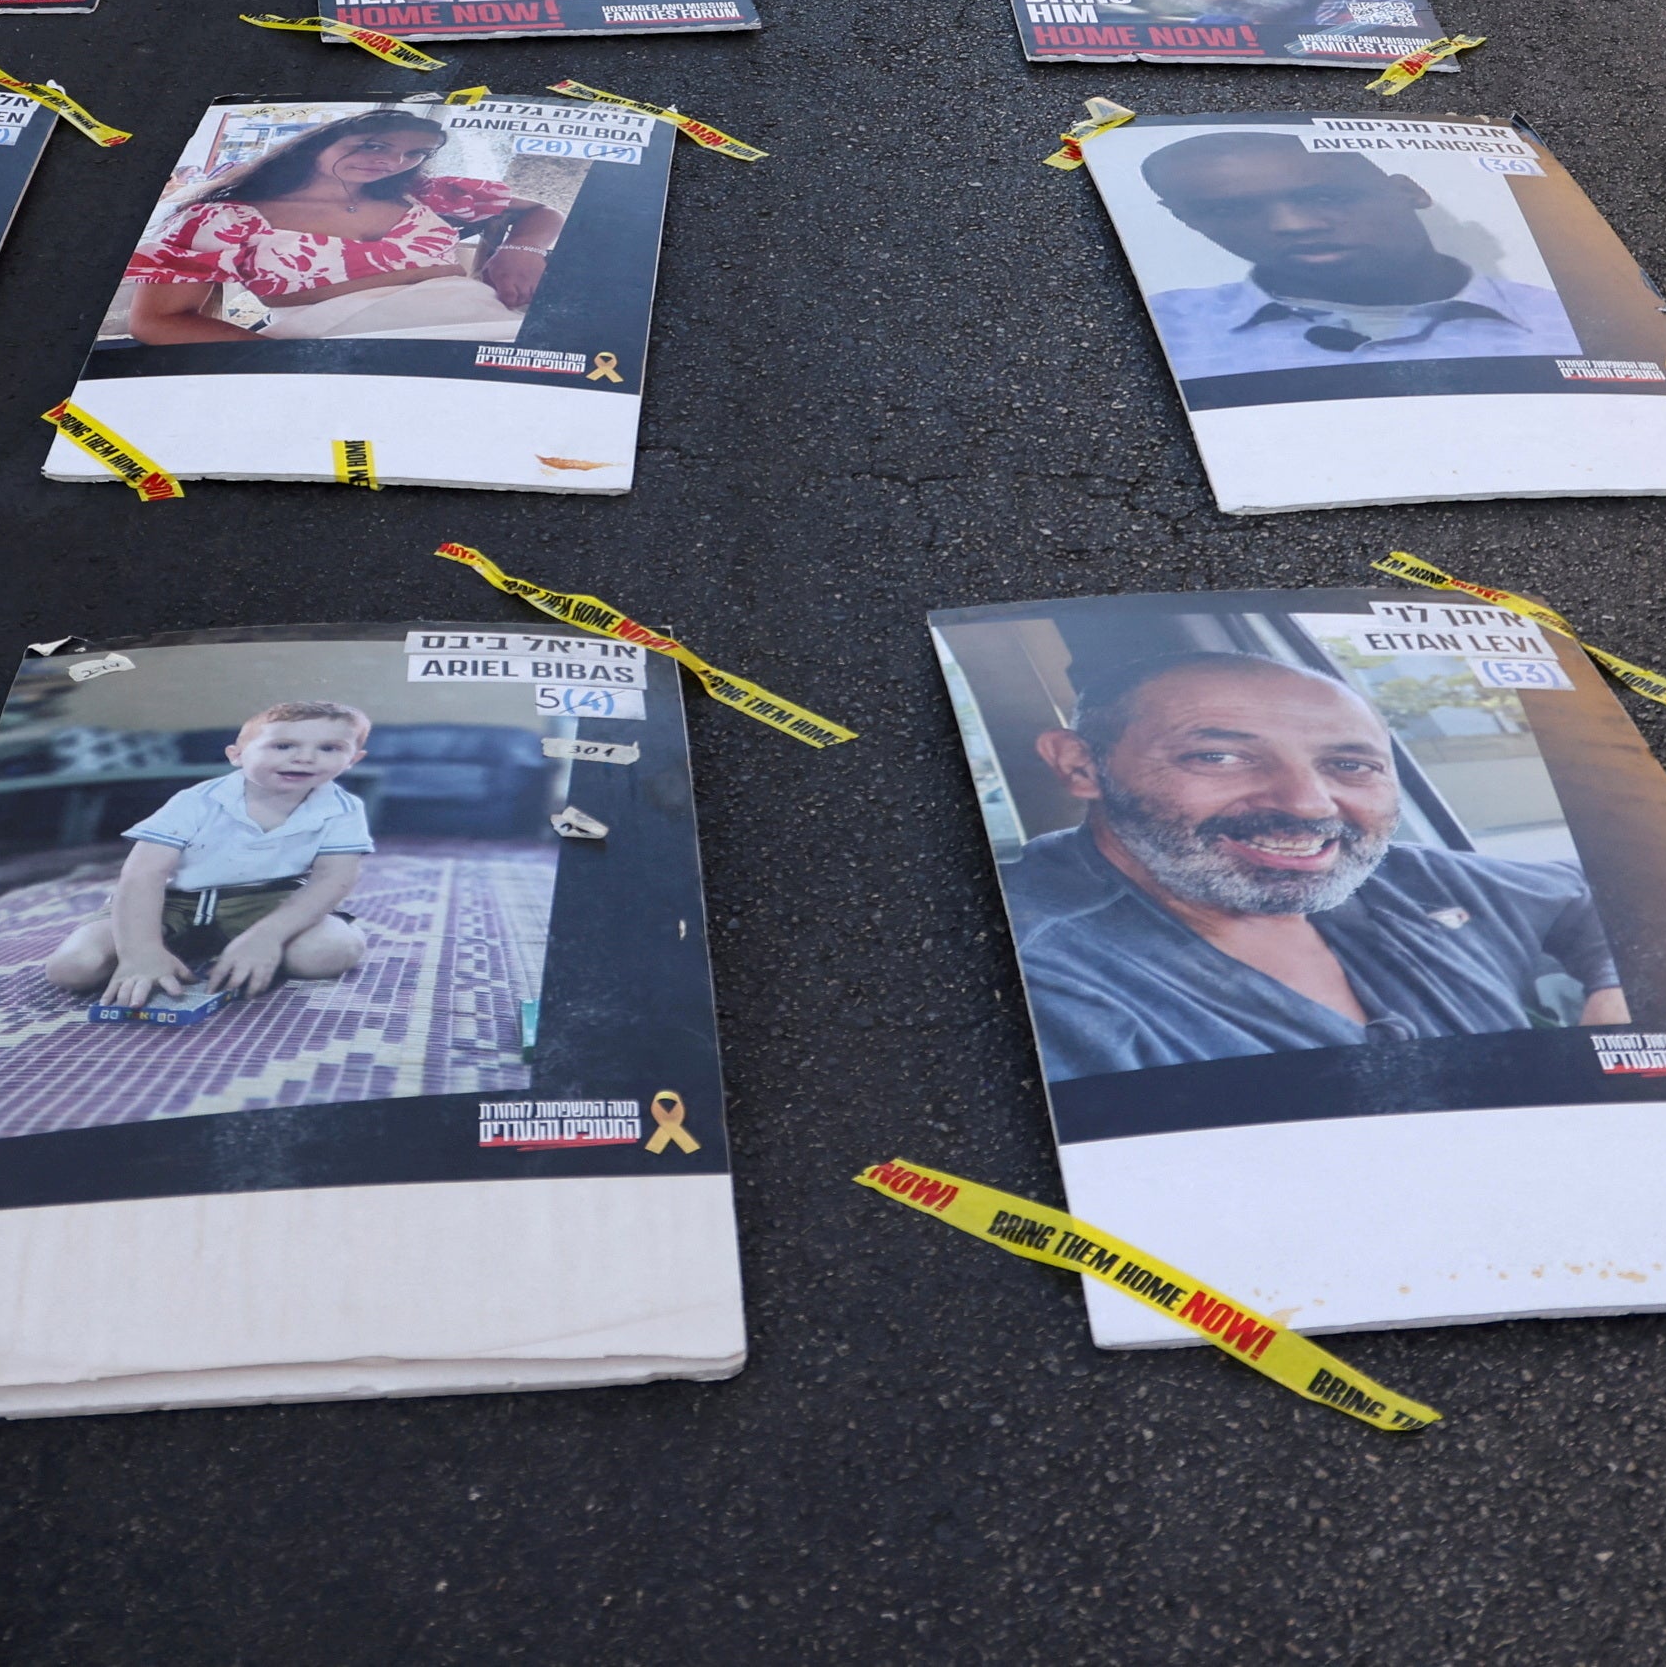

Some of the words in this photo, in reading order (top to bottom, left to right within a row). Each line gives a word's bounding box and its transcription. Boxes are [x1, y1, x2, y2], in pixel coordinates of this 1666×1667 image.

[336, 4, 442, 27] HOME
[601, 3, 661, 14] HOSTAGES
[661, 3, 685, 12] AND
[685, 1, 737, 11] MISSING
[603, 9, 679, 22] FAMILIES
[681, 8, 741, 20] FORUM
[1026, 3, 1099, 23] HIM
[1033, 25, 1141, 46] HOME
[1147, 24, 1261, 47] NOW!
[1297, 34, 1357, 44] HOSTAGES
[1302, 42, 1377, 55] FAMILIES
[449, 117, 552, 135] DANIELA
[558, 123, 644, 144] GILBOA
[515, 137, 574, 158] (20)
[1312, 137, 1391, 151] AVERA
[1393, 138, 1527, 158] MANGISTO
[1478, 156, 1538, 175] (36)
[82, 432, 115, 460] THEM
[110, 452, 149, 483] HOME
[1381, 604, 1429, 625] לוי
[1440, 607, 1527, 629] איתן
[420, 634, 509, 651] ביבס
[522, 635, 638, 660] אריאל
[1364, 632, 1463, 652] EITAN
[1473, 633, 1543, 656] LEVI
[420, 659, 520, 679] ARIEL
[531, 661, 636, 685] BIBAS
[1481, 659, 1562, 688] (53)
[478, 1100, 535, 1119] להחזרת
[535, 1099, 607, 1118] המשפחות
[606, 1099, 640, 1117] מטה
[479, 1119, 562, 1143] והנעדרים
[562, 1118, 642, 1141] החטופים
[868, 1160, 961, 1212] NOW!
[987, 1209, 1056, 1252] BRING
[1051, 1230, 1118, 1275] THEM
[1113, 1260, 1189, 1313] HOME
[1178, 1290, 1278, 1362] NOW!
[1305, 1367, 1385, 1420] BRING
